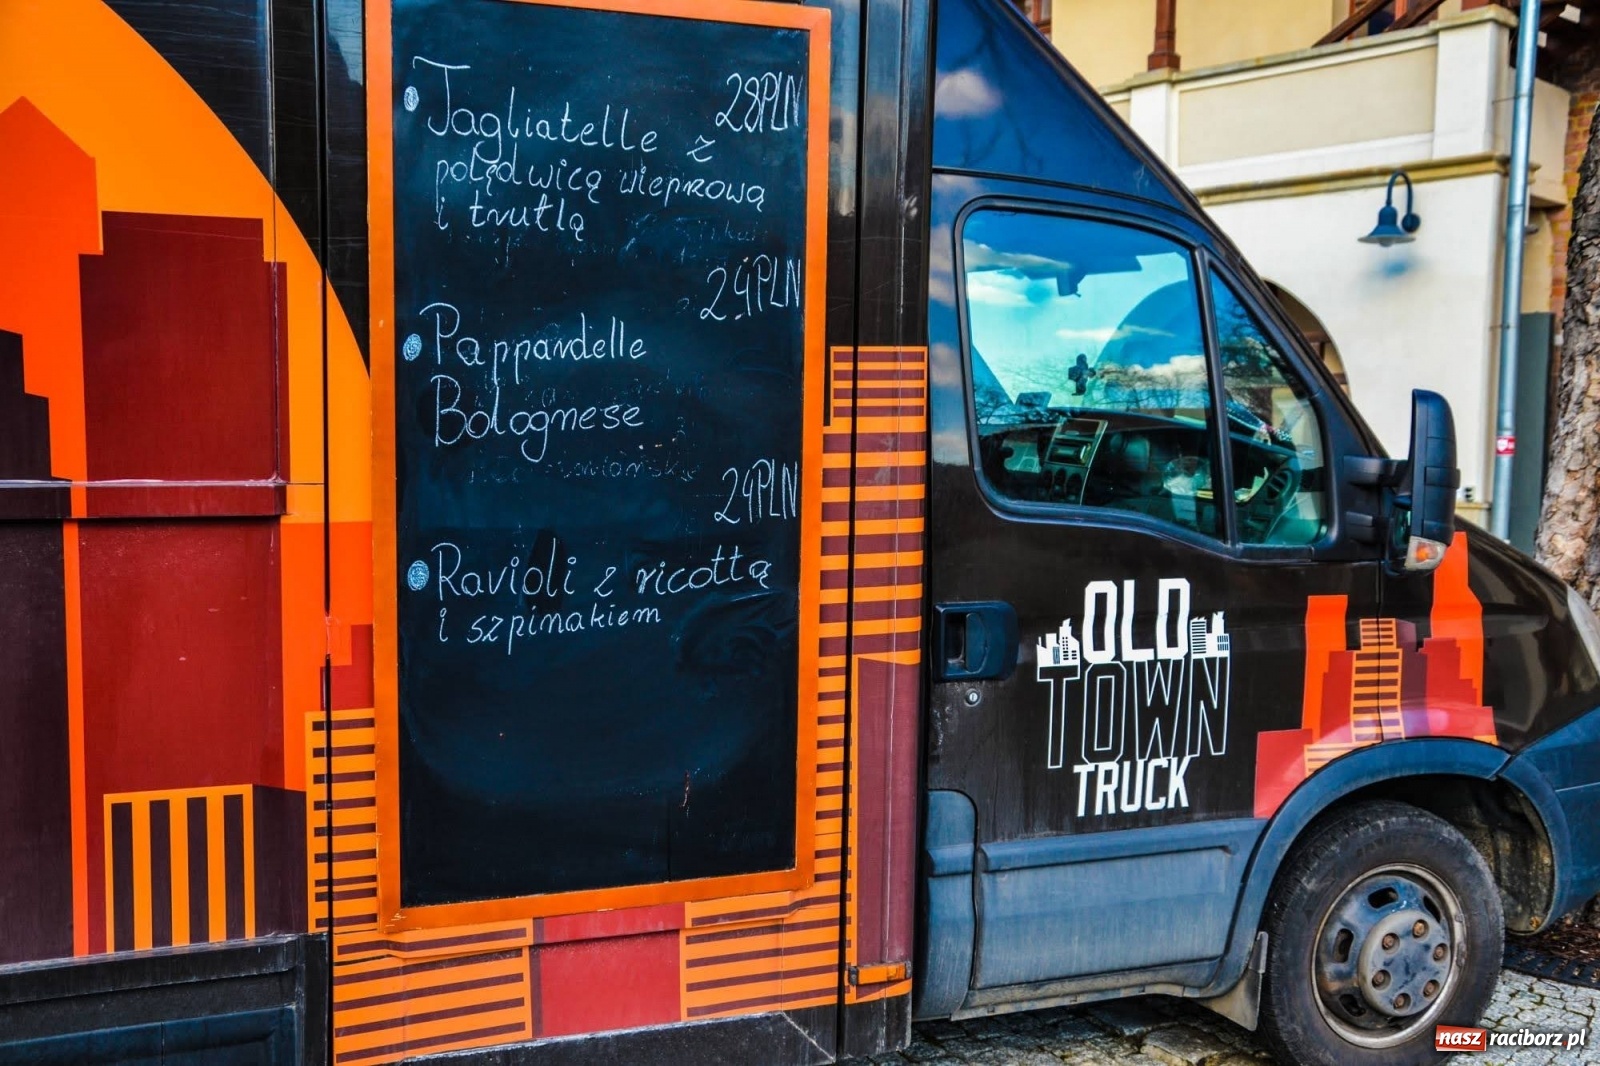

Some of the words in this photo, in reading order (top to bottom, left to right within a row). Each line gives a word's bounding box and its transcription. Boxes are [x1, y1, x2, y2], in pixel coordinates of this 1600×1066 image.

[412, 55, 658, 164] Tagliatelle
[686, 134, 716, 163] z
[437, 196, 449, 230] i
[430, 374, 645, 463] Bolognese
[430, 537, 577, 602] Ravioli
[593, 565, 618, 598] z
[439, 606, 449, 643] i
[466, 601, 663, 656] szpinakiem
[1082, 577, 1191, 664] OLD
[1036, 655, 1231, 769] TOWN
[1072, 756, 1190, 818] TRUCK
